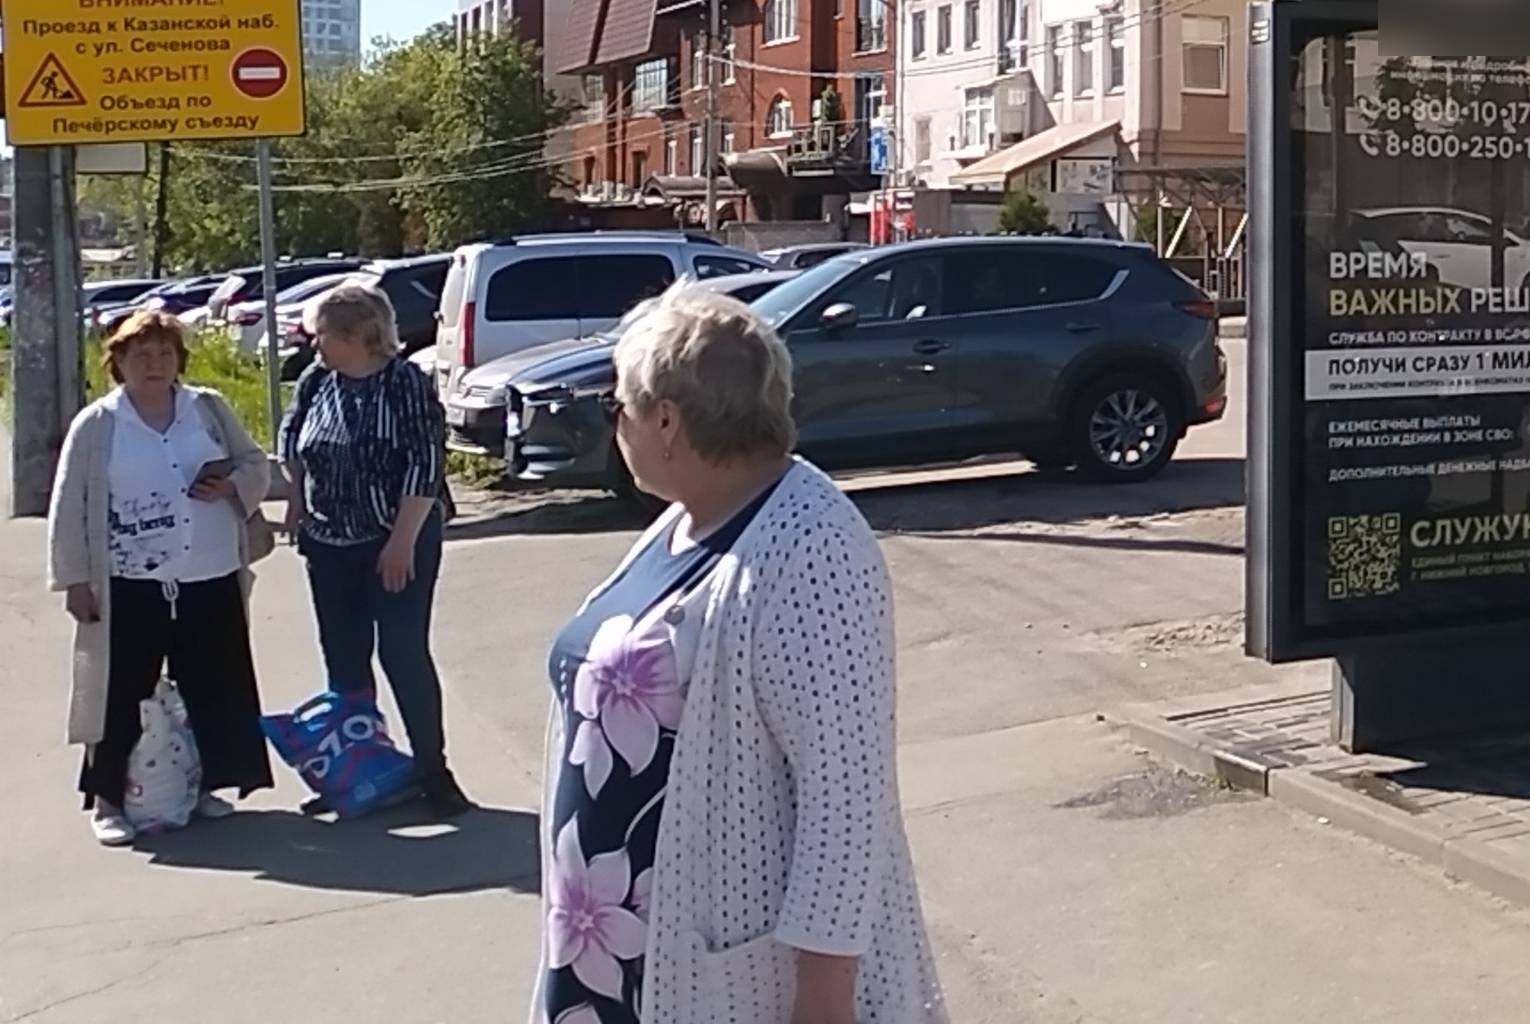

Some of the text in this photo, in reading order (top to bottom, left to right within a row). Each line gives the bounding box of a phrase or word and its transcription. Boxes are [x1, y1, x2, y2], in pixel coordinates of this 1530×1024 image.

[23, 13, 280, 37] Проезд к Казанской наб.
[75, 37, 231, 57] с ул. Сеченова
[102, 64, 210, 84] ЗАКРЫТ!
[99, 95, 212, 111] Объезд по
[185, 114, 259, 131] съезду
[1329, 251, 1427, 279] ВРЕМЯ
[1329, 287, 1461, 316] ВАЖНЫХ
[1328, 330, 1385, 345] СЛУЖБА
[1387, 330, 1407, 343] ПО
[1484, 328, 1493, 340] В
[1328, 357, 1406, 376] ПОЛУЧИ
[1412, 354, 1470, 373] СРАЗУ
[1475, 353, 1484, 370] 1
[1328, 414, 1481, 433] ЕЖЕМЕСЯЧНЫЕ ВЫПЛАТЫ
[1328, 436, 1354, 448] ПРИ
[1356, 432, 1440, 447] НАХОЖДЕНИИ
[1443, 431, 1451, 443] В
[1453, 429, 1483, 443] ЗОНЕ
[1328, 461, 1435, 482] ДОПОЛНИТЕЛЬНЫЕ
[1437, 459, 1496, 475] ДЕНЕЖНЫЕ
